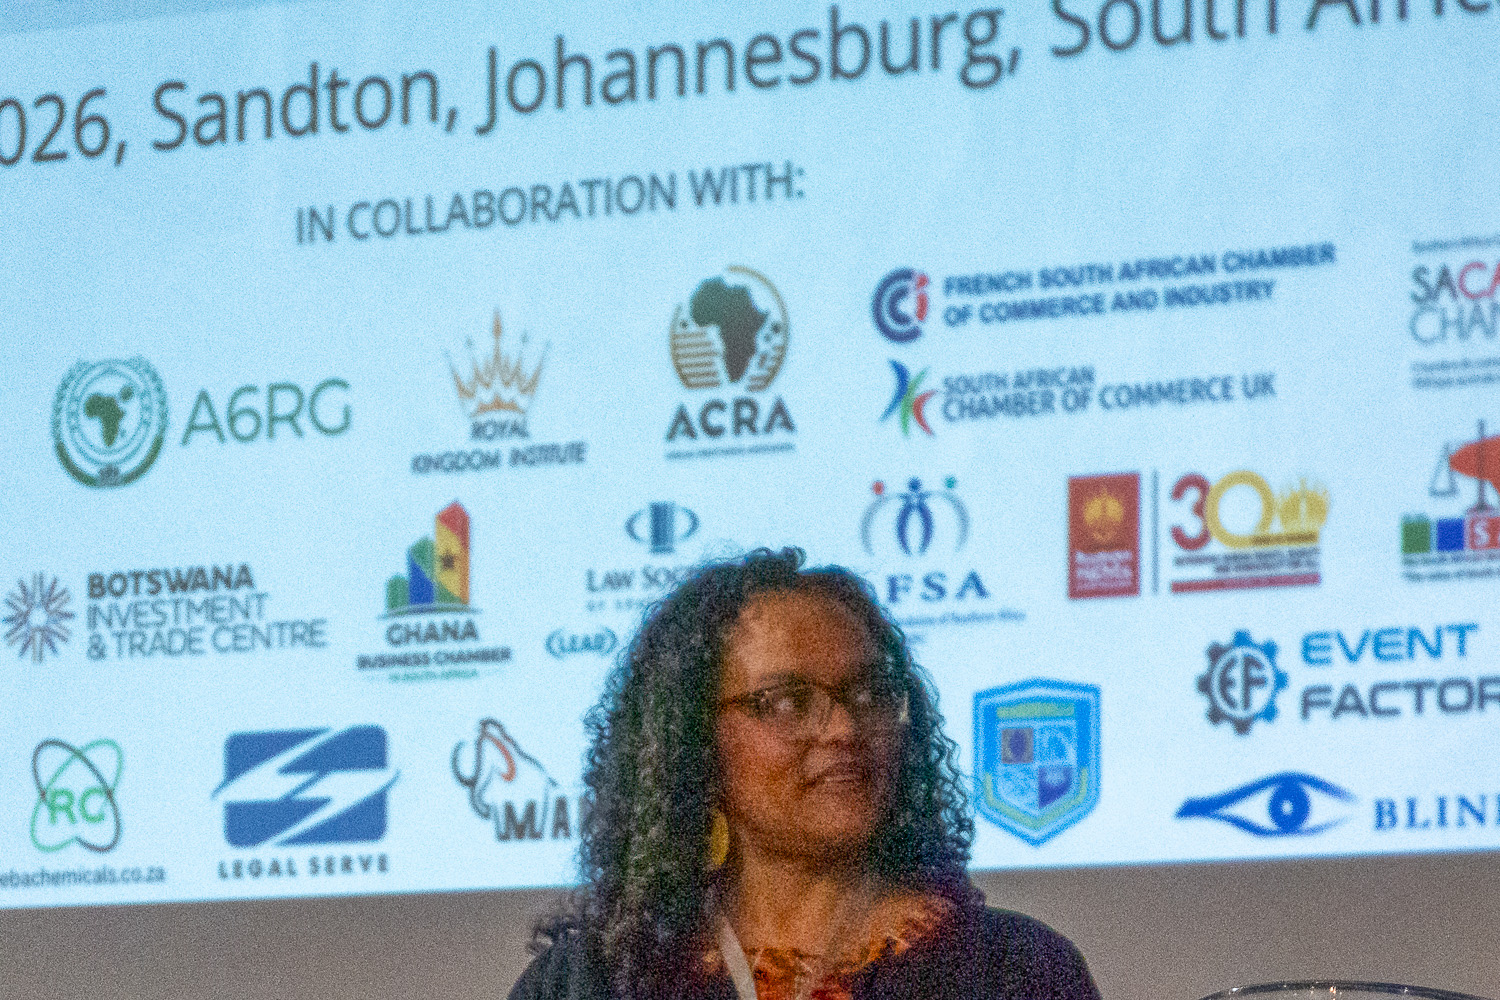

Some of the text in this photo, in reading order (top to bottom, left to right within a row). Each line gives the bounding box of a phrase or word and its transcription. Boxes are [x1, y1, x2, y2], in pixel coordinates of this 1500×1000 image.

[152, 62, 458, 151] Sandton,
[476, 5, 1021, 136] Johannesburg,
[296, 160, 805, 244] IN COLLABORATION WITH:
[942, 242, 1337, 299] FRENCH SOUTH AFRICAN CHAMBER
[943, 279, 1277, 327] OF COMMERCE AND INDUSTRY
[942, 366, 1095, 396] SOUTH AFRICAN
[942, 371, 1277, 422] CHAMBER OF COMMERCE UK
[181, 377, 352, 446] A6RG
[471, 418, 529, 441] ROYAL
[667, 396, 796, 443] ACRA
[411, 441, 587, 475] KINGDOM INSTITUTE
[87, 564, 255, 599] BOTSWANA
[586, 568, 633, 594] LAW
[887, 568, 991, 602] FSA
[87, 593, 269, 630] INVESTMENT
[87, 619, 329, 660] & TRADE CENTRE
[1301, 623, 1478, 665] EVENT
[218, 853, 389, 880] LEGAL SERVE
